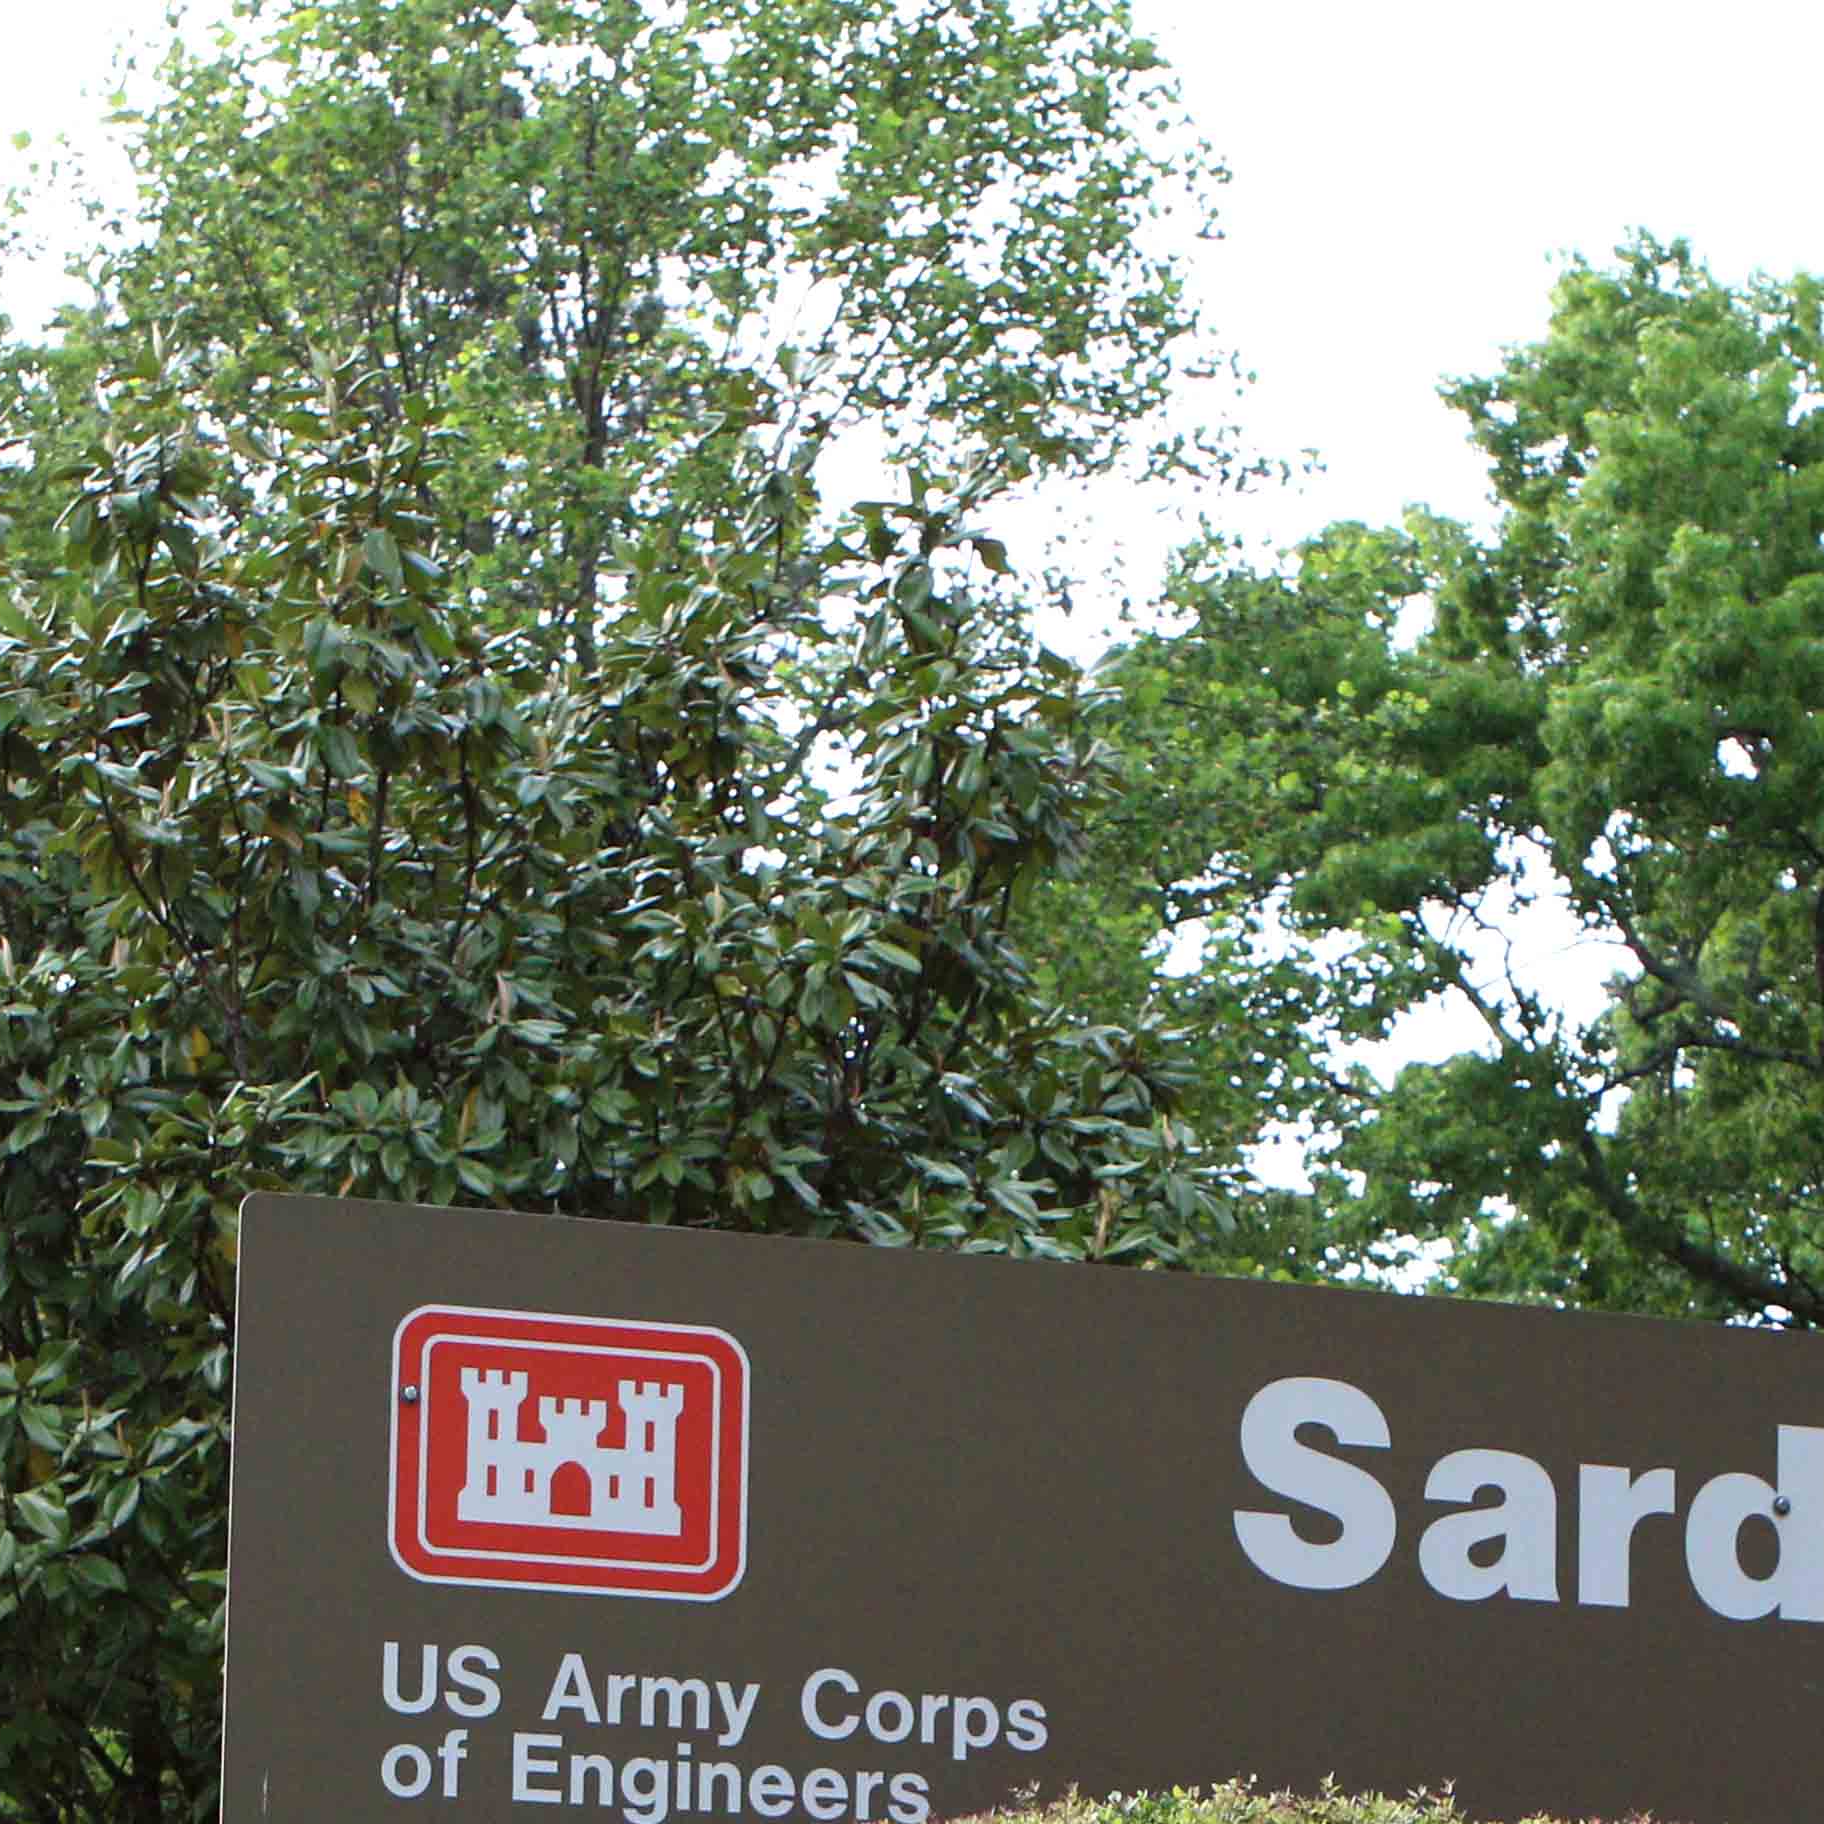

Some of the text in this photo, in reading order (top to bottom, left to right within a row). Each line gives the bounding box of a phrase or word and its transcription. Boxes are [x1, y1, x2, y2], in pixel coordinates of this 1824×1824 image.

[380, 1639, 1050, 1762] US Army Corps
[380, 1727, 469, 1800] of
